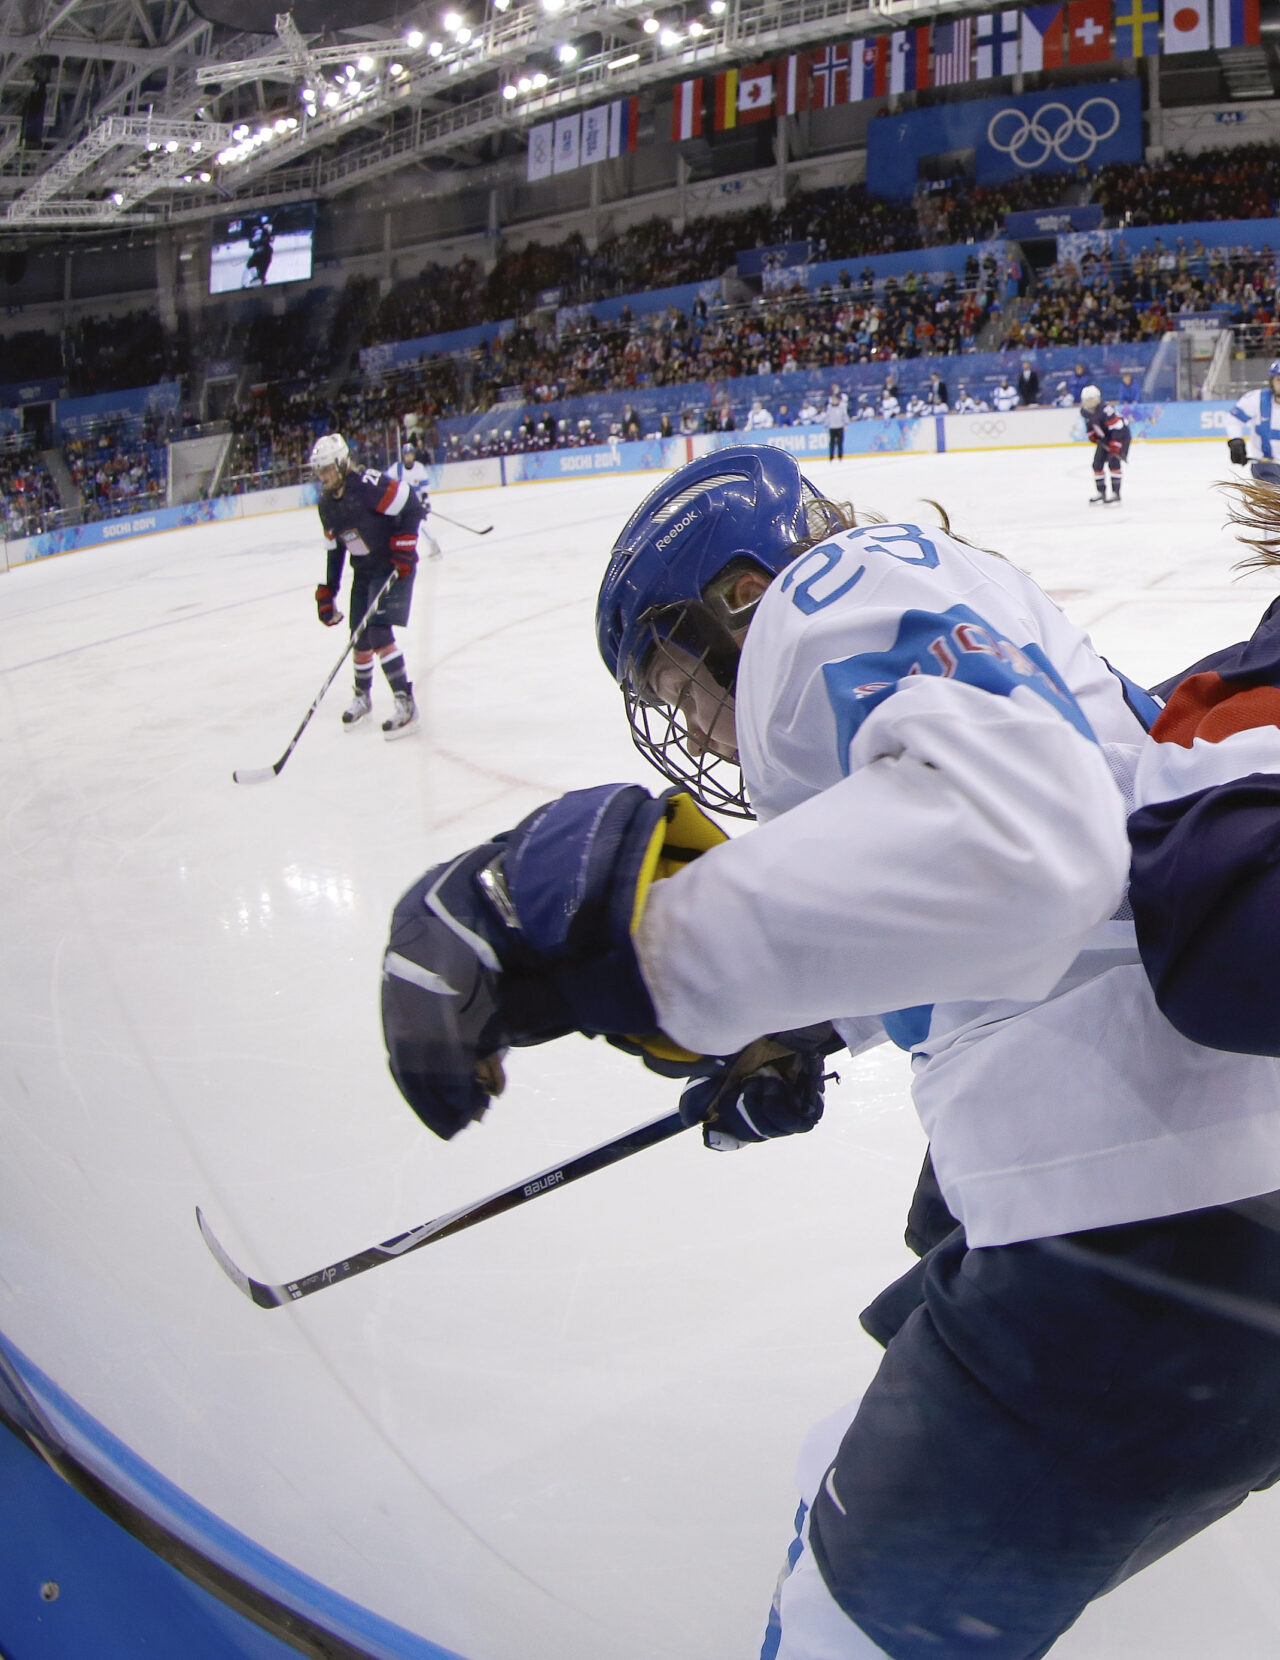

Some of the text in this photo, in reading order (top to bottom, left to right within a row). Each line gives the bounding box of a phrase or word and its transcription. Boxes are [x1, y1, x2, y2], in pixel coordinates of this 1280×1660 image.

[560, 452, 622, 471] SOCHI 2014
[103, 517, 157, 538] SOCHI 2014
[655, 510, 698, 551] Reebok
[780, 523, 940, 616] 23
